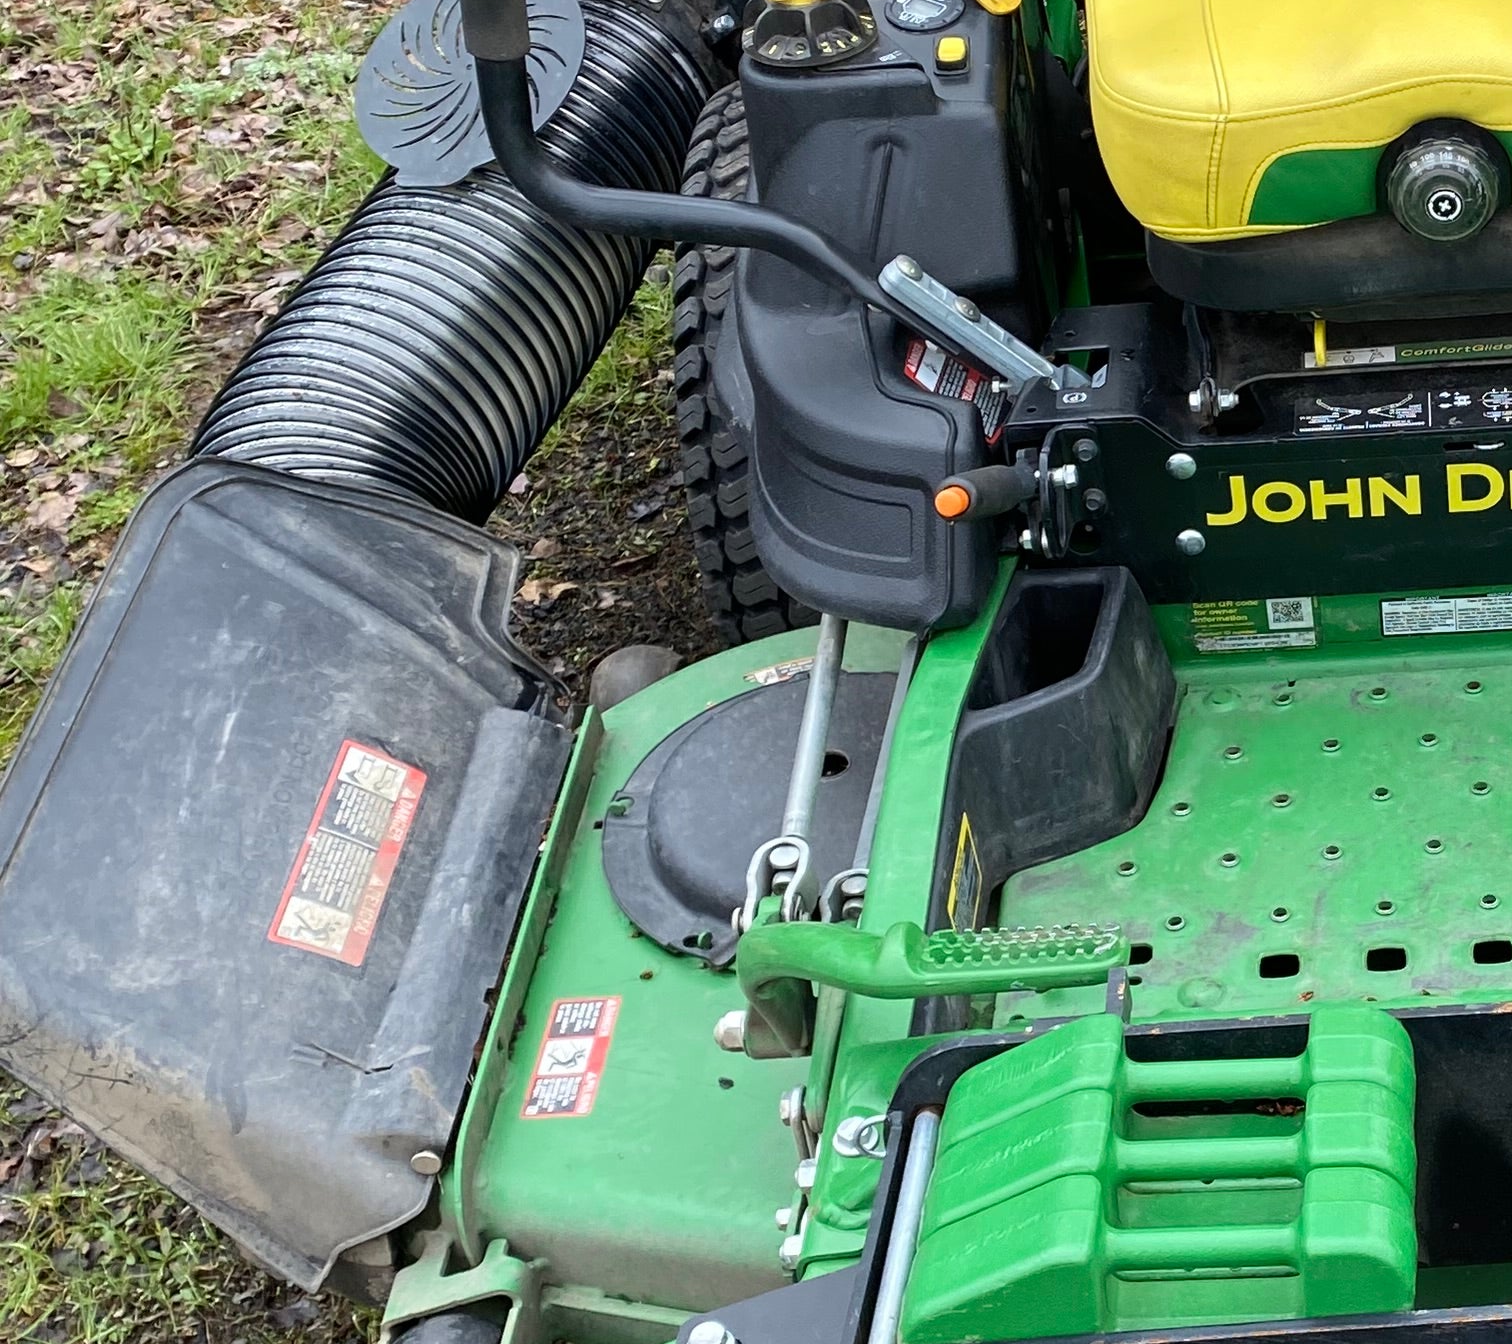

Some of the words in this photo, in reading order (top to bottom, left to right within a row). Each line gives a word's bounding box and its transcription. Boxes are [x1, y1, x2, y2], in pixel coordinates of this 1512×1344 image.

[1400, 342, 1512, 357] ComfortGlide
[1206, 474, 1422, 526] JOHN
[387, 799, 414, 842] DANGER
